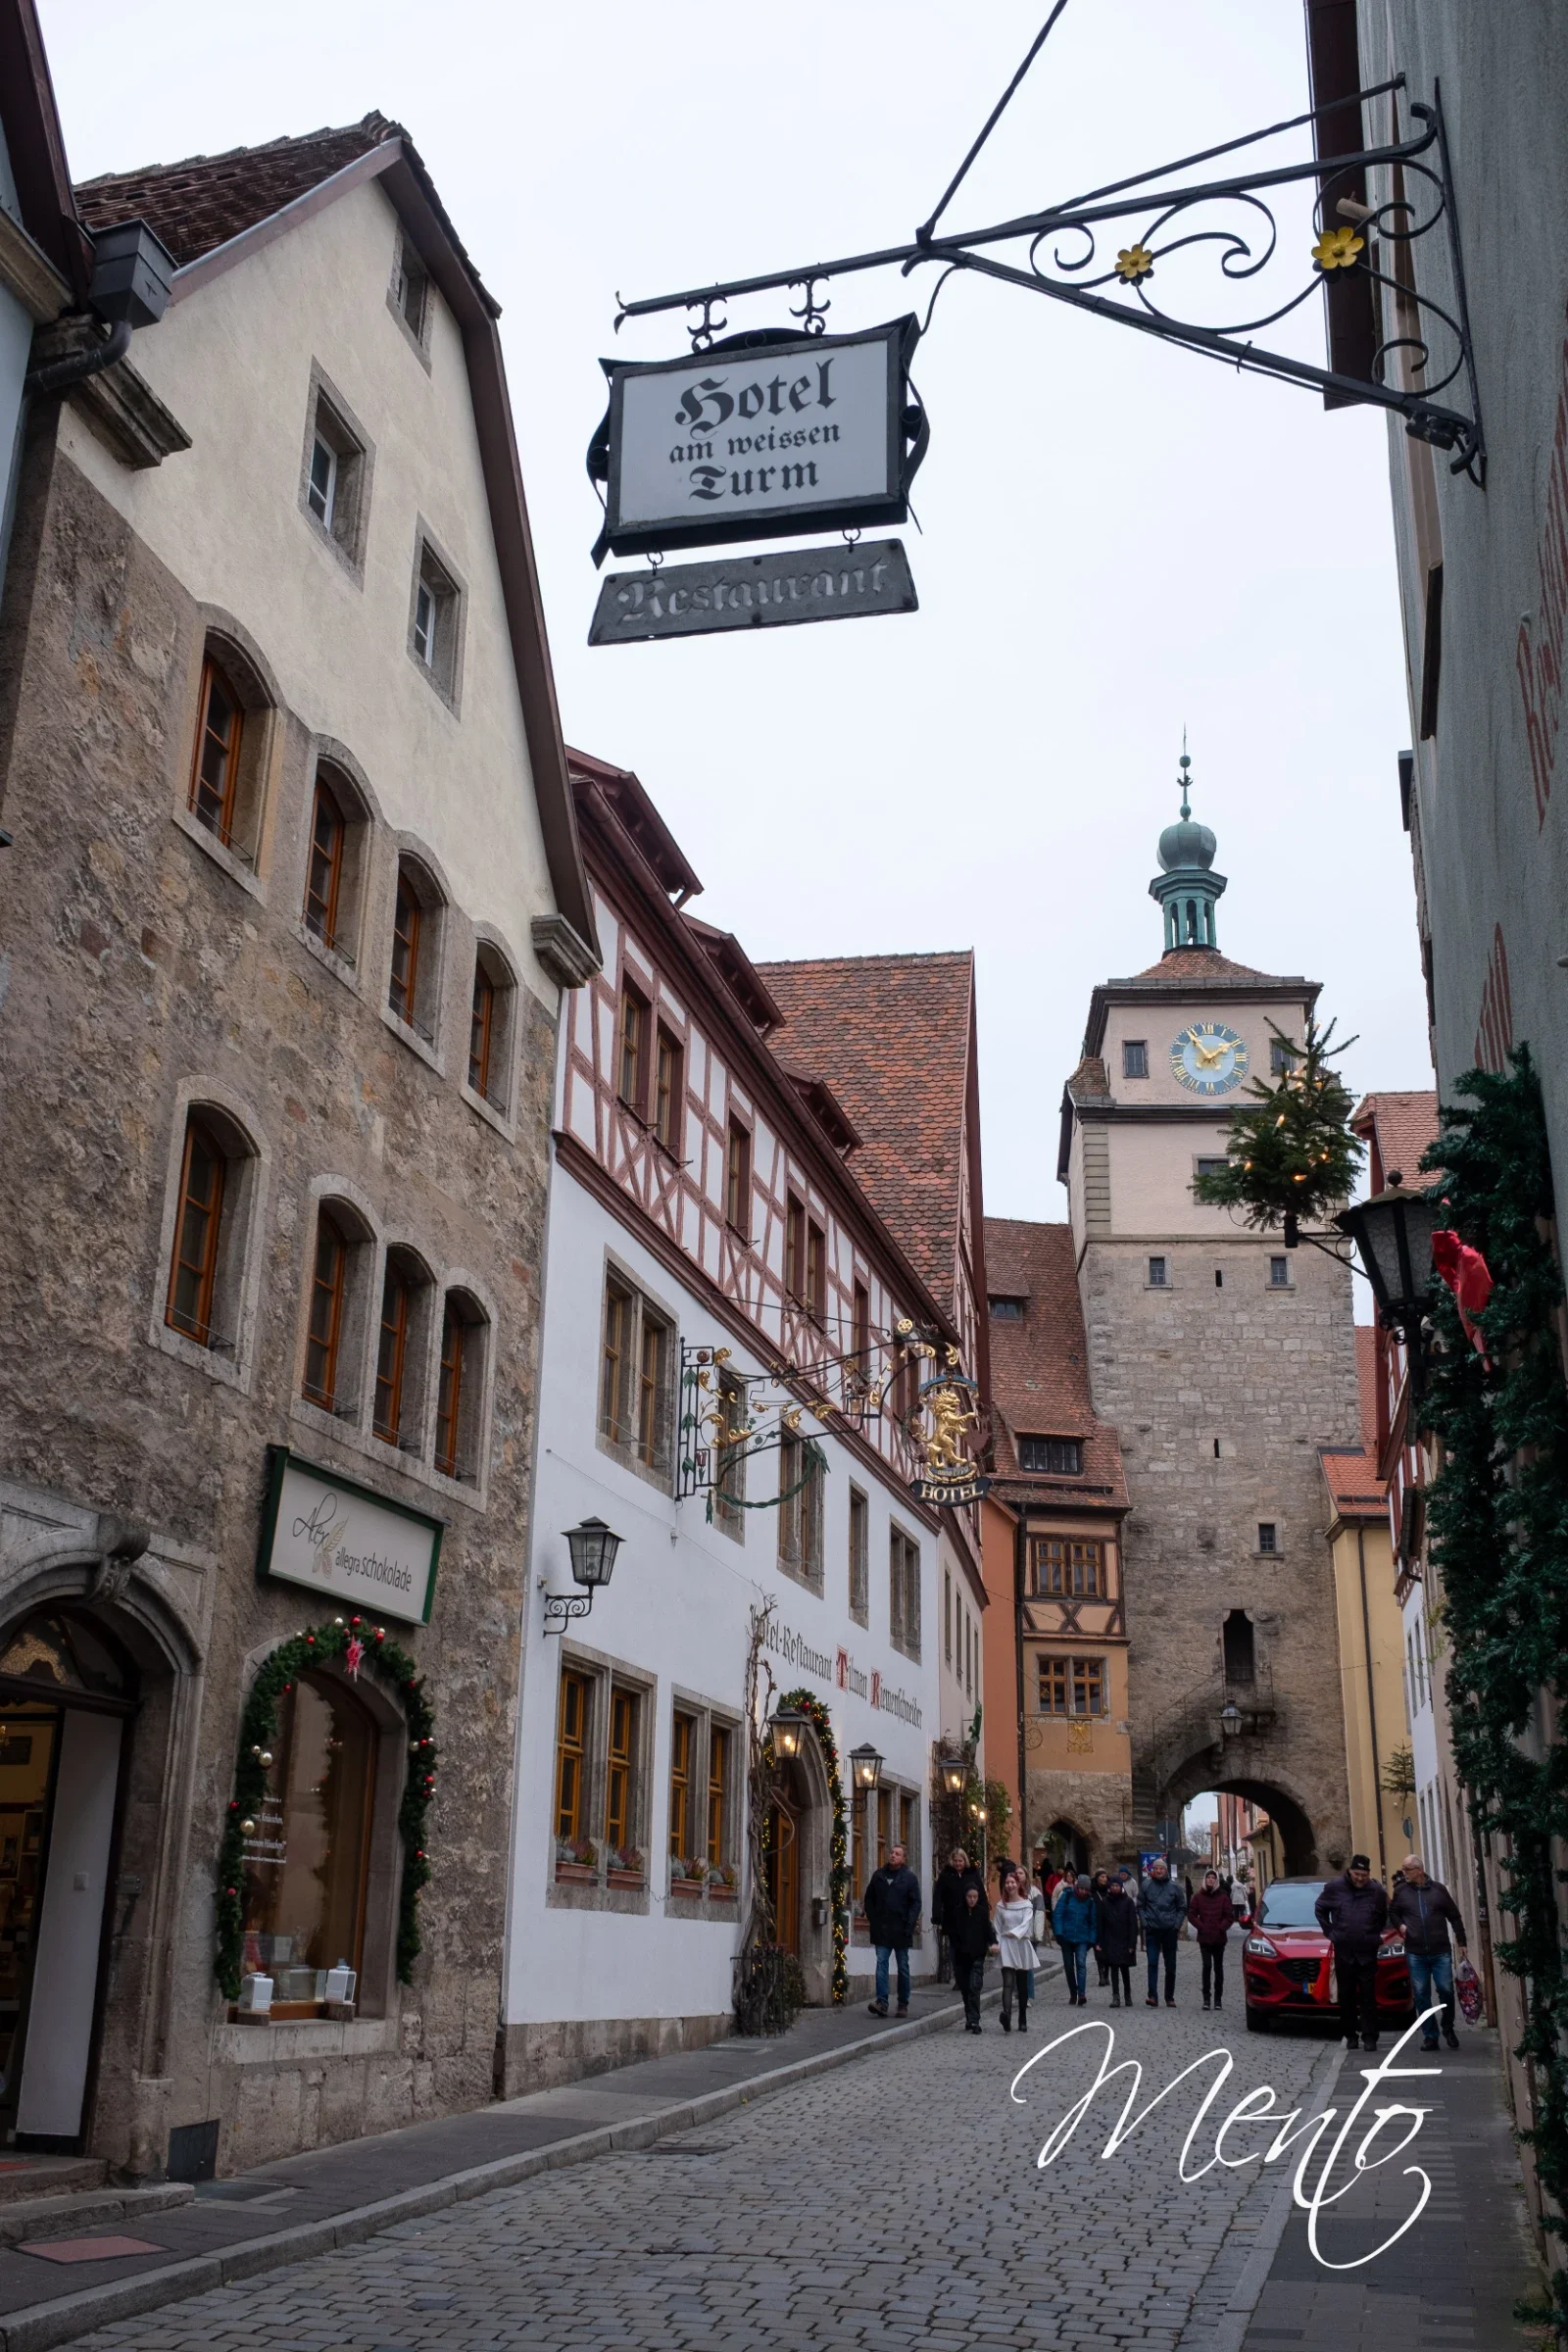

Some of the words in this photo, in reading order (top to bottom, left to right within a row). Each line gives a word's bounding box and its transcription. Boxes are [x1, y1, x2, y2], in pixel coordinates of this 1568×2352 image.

[674, 357, 838, 441] Hotel
[668, 441, 713, 465] am
[727, 422, 842, 457] weissen
[688, 460, 820, 501] Turm
[616, 558, 888, 623] Restaurant
[920, 1482, 983, 1503] HOTEL
[335, 1545, 360, 1577] allegra
[362, 1551, 412, 1592] schokolade
[836, 1648, 867, 1701] Tilman
